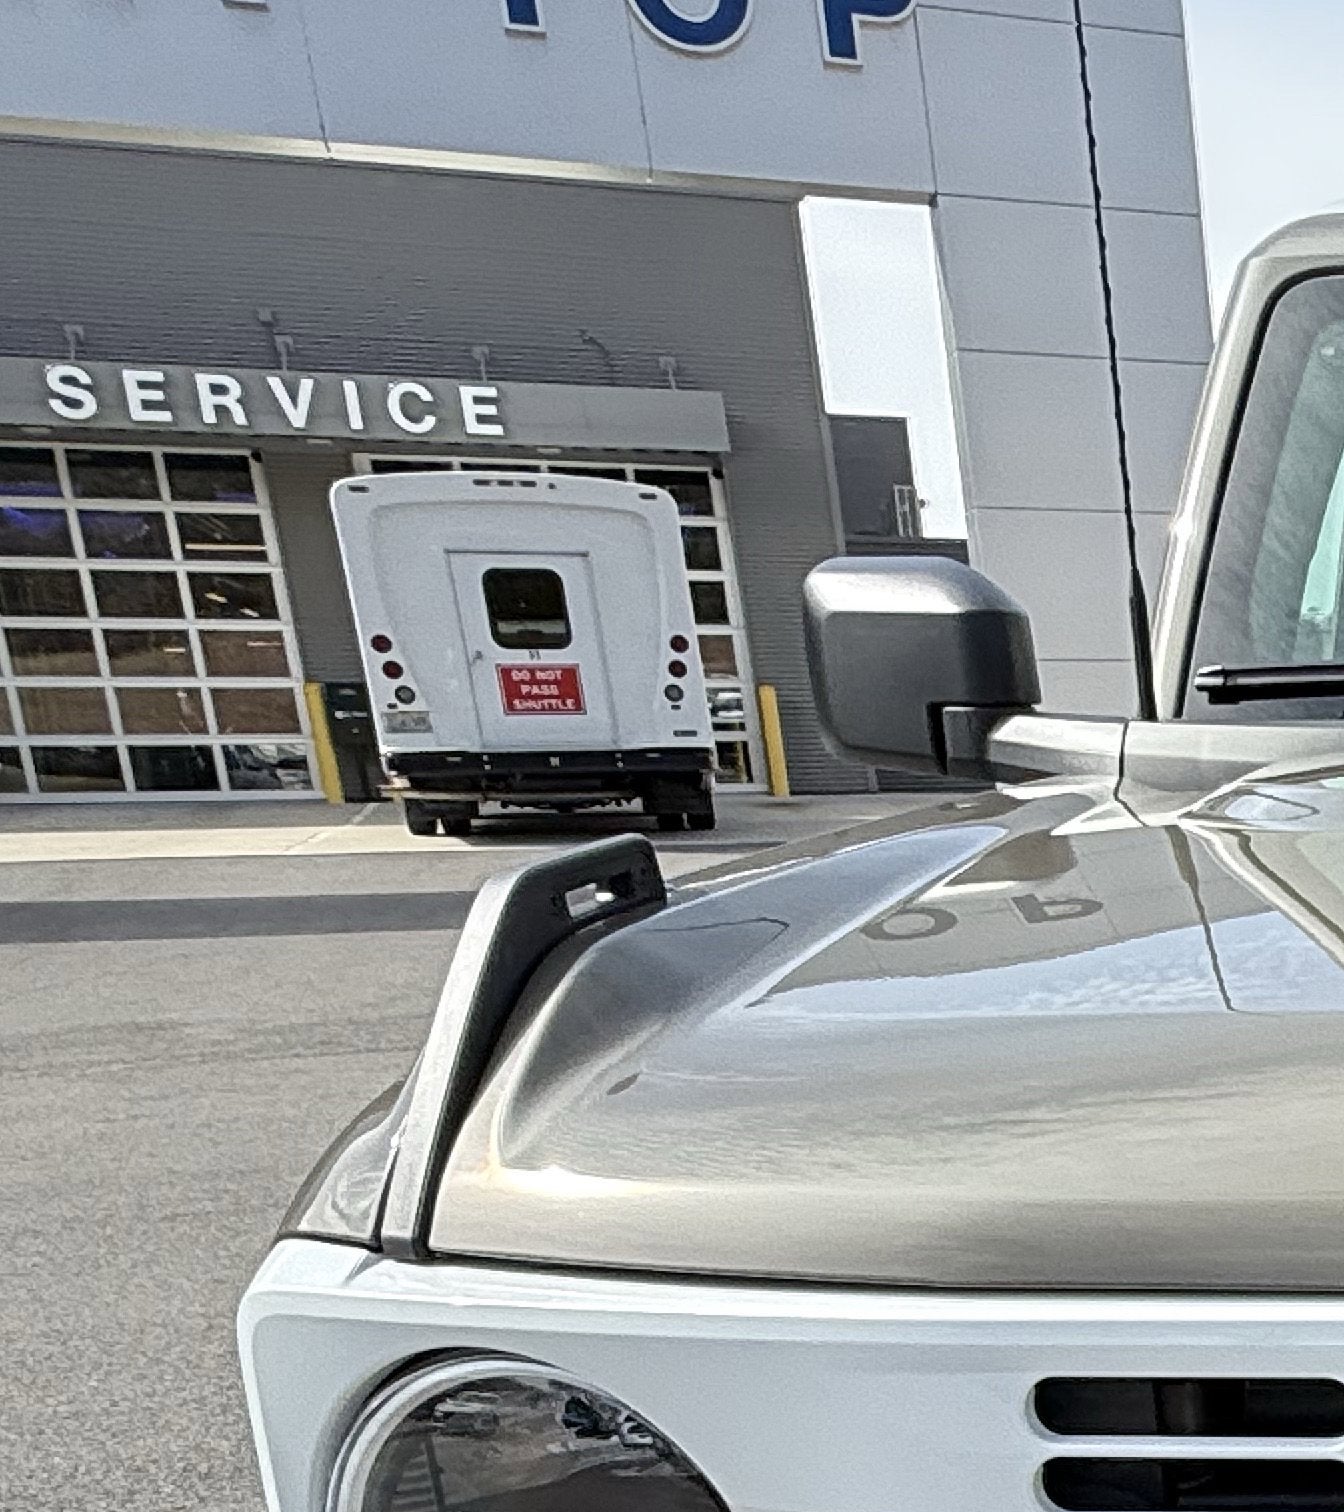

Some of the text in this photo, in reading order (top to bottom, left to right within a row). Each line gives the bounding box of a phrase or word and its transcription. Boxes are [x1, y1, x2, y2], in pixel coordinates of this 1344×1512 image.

[45, 364, 506, 436] SERVICE
[511, 669, 562, 681] DO NOT
[520, 684, 560, 696] PASS
[512, 698, 576, 710] SHUTTLE
